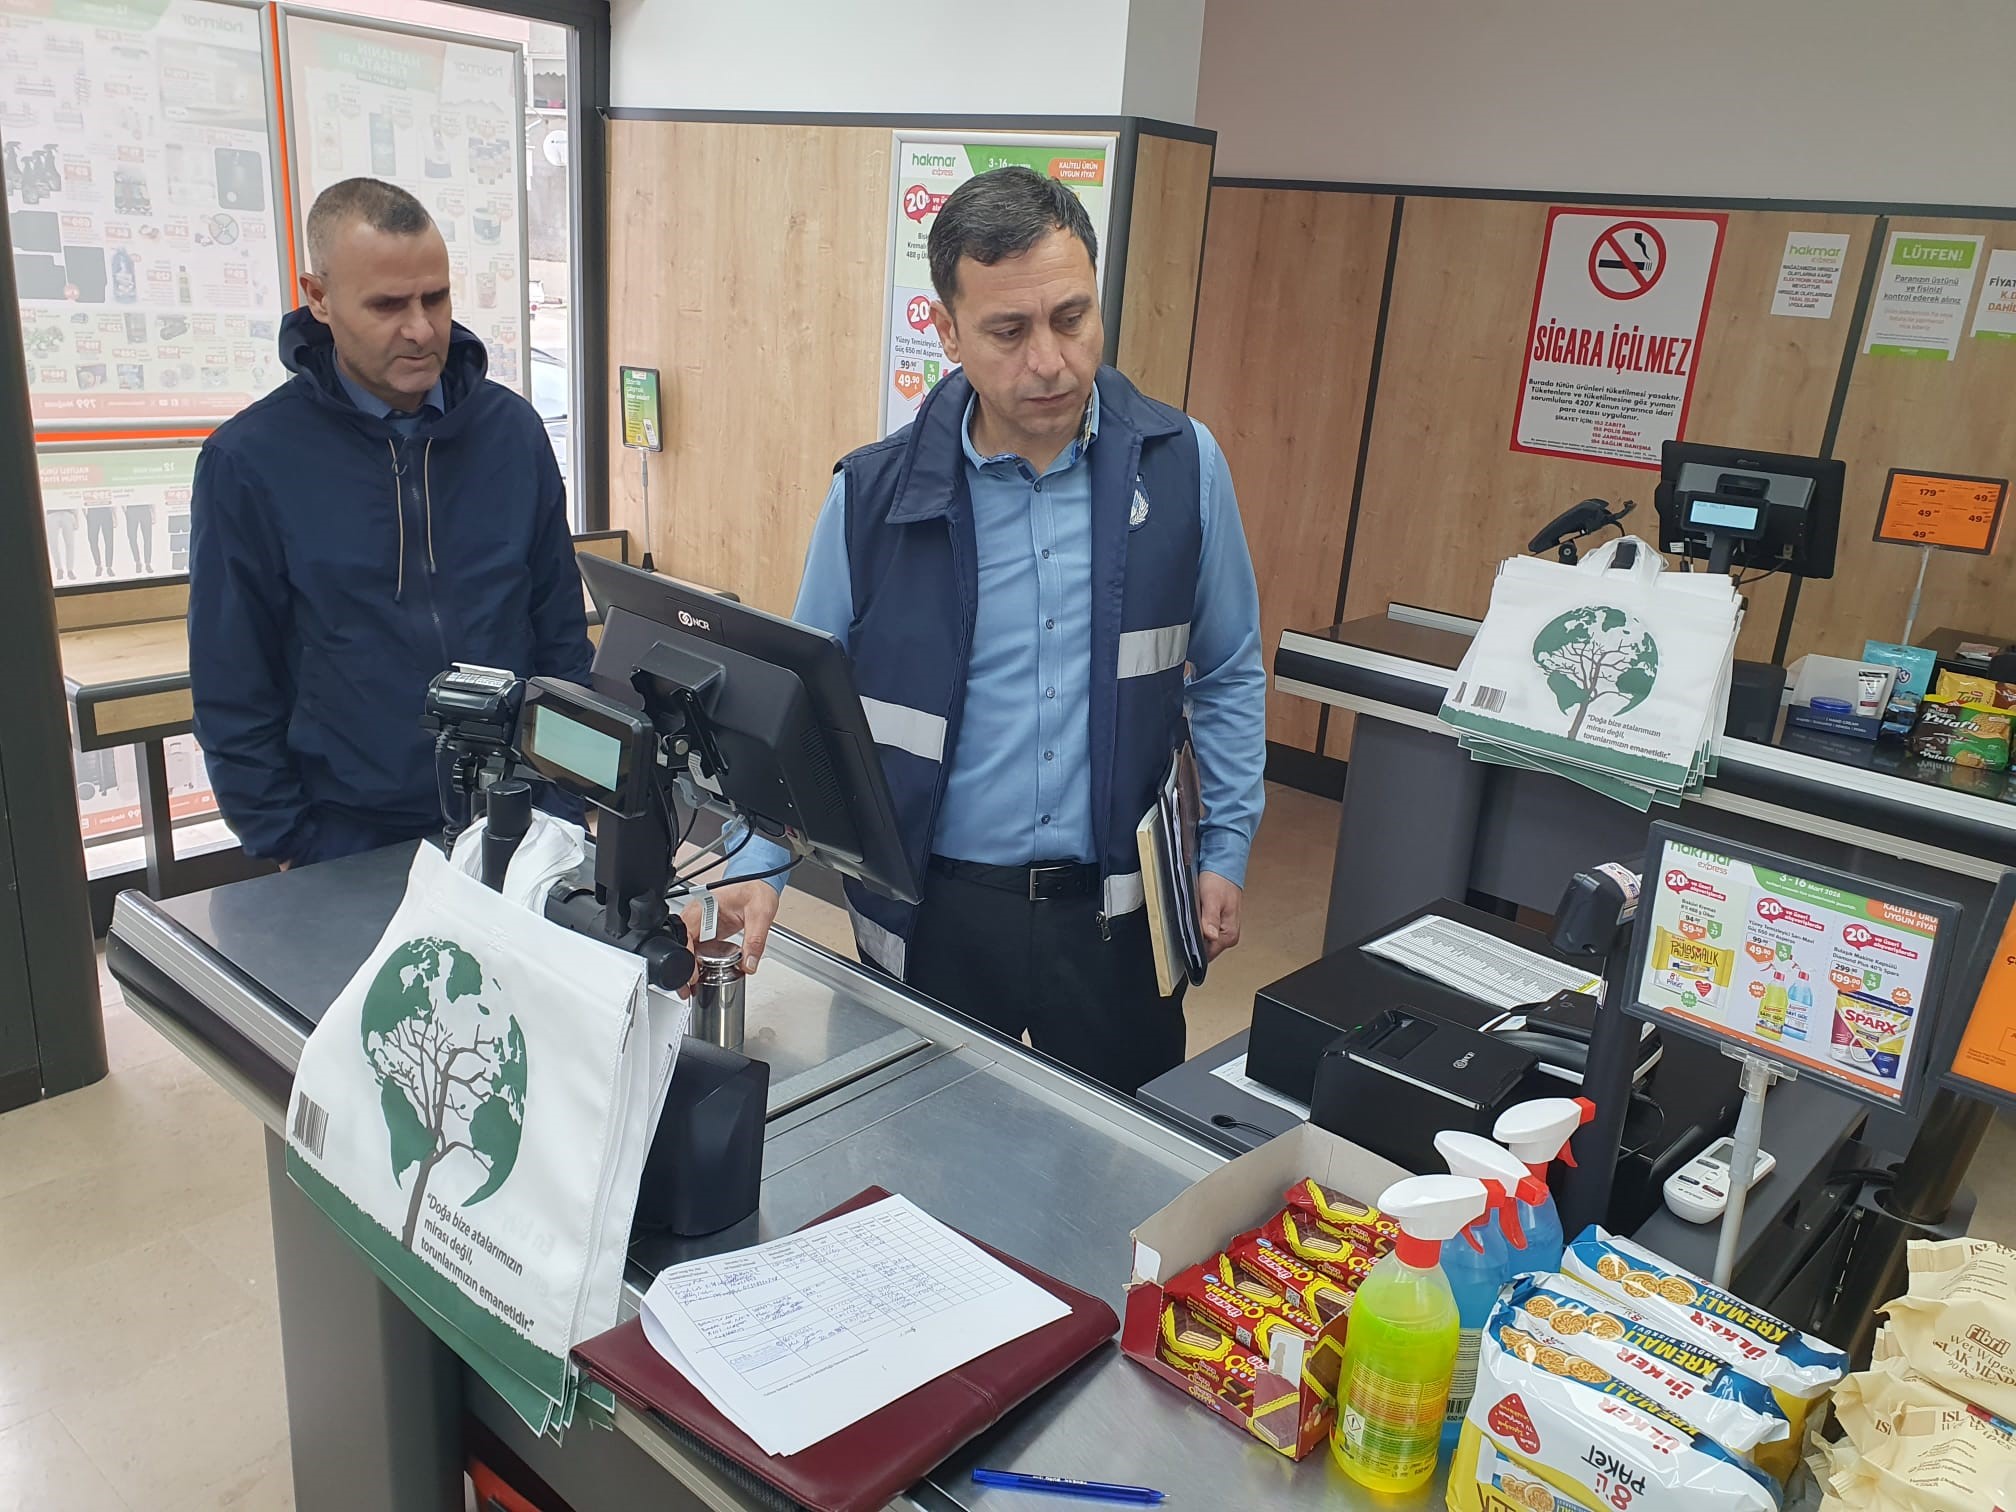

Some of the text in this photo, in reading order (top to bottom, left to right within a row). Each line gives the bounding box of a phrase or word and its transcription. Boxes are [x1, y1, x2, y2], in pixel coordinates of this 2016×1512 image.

[912, 153, 956, 168] hakmar
[1060, 169, 1096, 179] UYGUN FİYAT
[1790, 244, 1842, 257] hakmar
[1902, 244, 1964, 262] LÜTFEN!
[1895, 274, 1960, 286] Paranızın üstünü
[1884, 292, 1912, 302] kontrol
[1912, 295, 1939, 303] ederek
[895, 336, 937, 349] Yüzey Temizleyici
[895, 345, 905, 354] Güç
[905, 346, 915, 355] 650
[1533, 317, 1693, 377] SİGARA İÇİLMEZ
[927, 373, 936, 383] 50
[1529, 378, 1681, 402] Burada tütün ürünleri tüketilmesi yasaktır.
[1531, 386, 1572, 397] Tüketenlere
[1583, 392, 1632, 404] tüketilmesine
[1633, 398, 1648, 407] göz
[1649, 400, 1676, 409] yuman
[1531, 395, 1674, 417] sorumlulara 4207 Kanun uyarınca idari
[1578, 407, 1601, 416] cezası
[1601, 411, 1640, 421] uygulanır.
[1603, 426, 1621, 435] POLİS
[1604, 421, 1626, 429] ZABITA
[1602, 433, 1635, 442] JANDARMA
[1919, 488, 1937, 497] 179
[1973, 494, 1988, 502] 49
[1917, 509, 1932, 518] 49
[1968, 514, 1983, 523] 49
[1912, 530, 1927, 538] 49
[691, 617, 710, 631] NCR
[1957, 690, 1982, 703] Tam
[1607, 718, 1622, 728] bize
[1622, 722, 1661, 738] atalarımızın
[1921, 712, 1980, 731] Yulaflı
[1586, 724, 1625, 739] mirası değil,
[1583, 732, 1629, 750] torunlarımızın
[1697, 861, 1728, 876] express
[1807, 885, 1825, 895] Mart
[1883, 911, 1916, 928] UYGUN
[1844, 1008, 1898, 1036] SPARX
[424, 1217, 474, 1266] mirası değil,
[452, 1210, 472, 1239] bize
[472, 1228, 524, 1277] atalarımızın
[420, 1236, 479, 1293] torunlarımızın
[1694, 1293, 1789, 1343] KREMALI
[1689, 1310, 1768, 1361] ÜLKER
[1967, 1326, 2012, 1356] Fibril
[1621, 1330, 1719, 1377] KREMALI
[1951, 1335, 2015, 1376] Wet Wipes
[1946, 1359, 1960, 1370] 90
[1616, 1346, 1696, 1400] ÜLKER
[1597, 1396, 1681, 1455] ÜLKER
